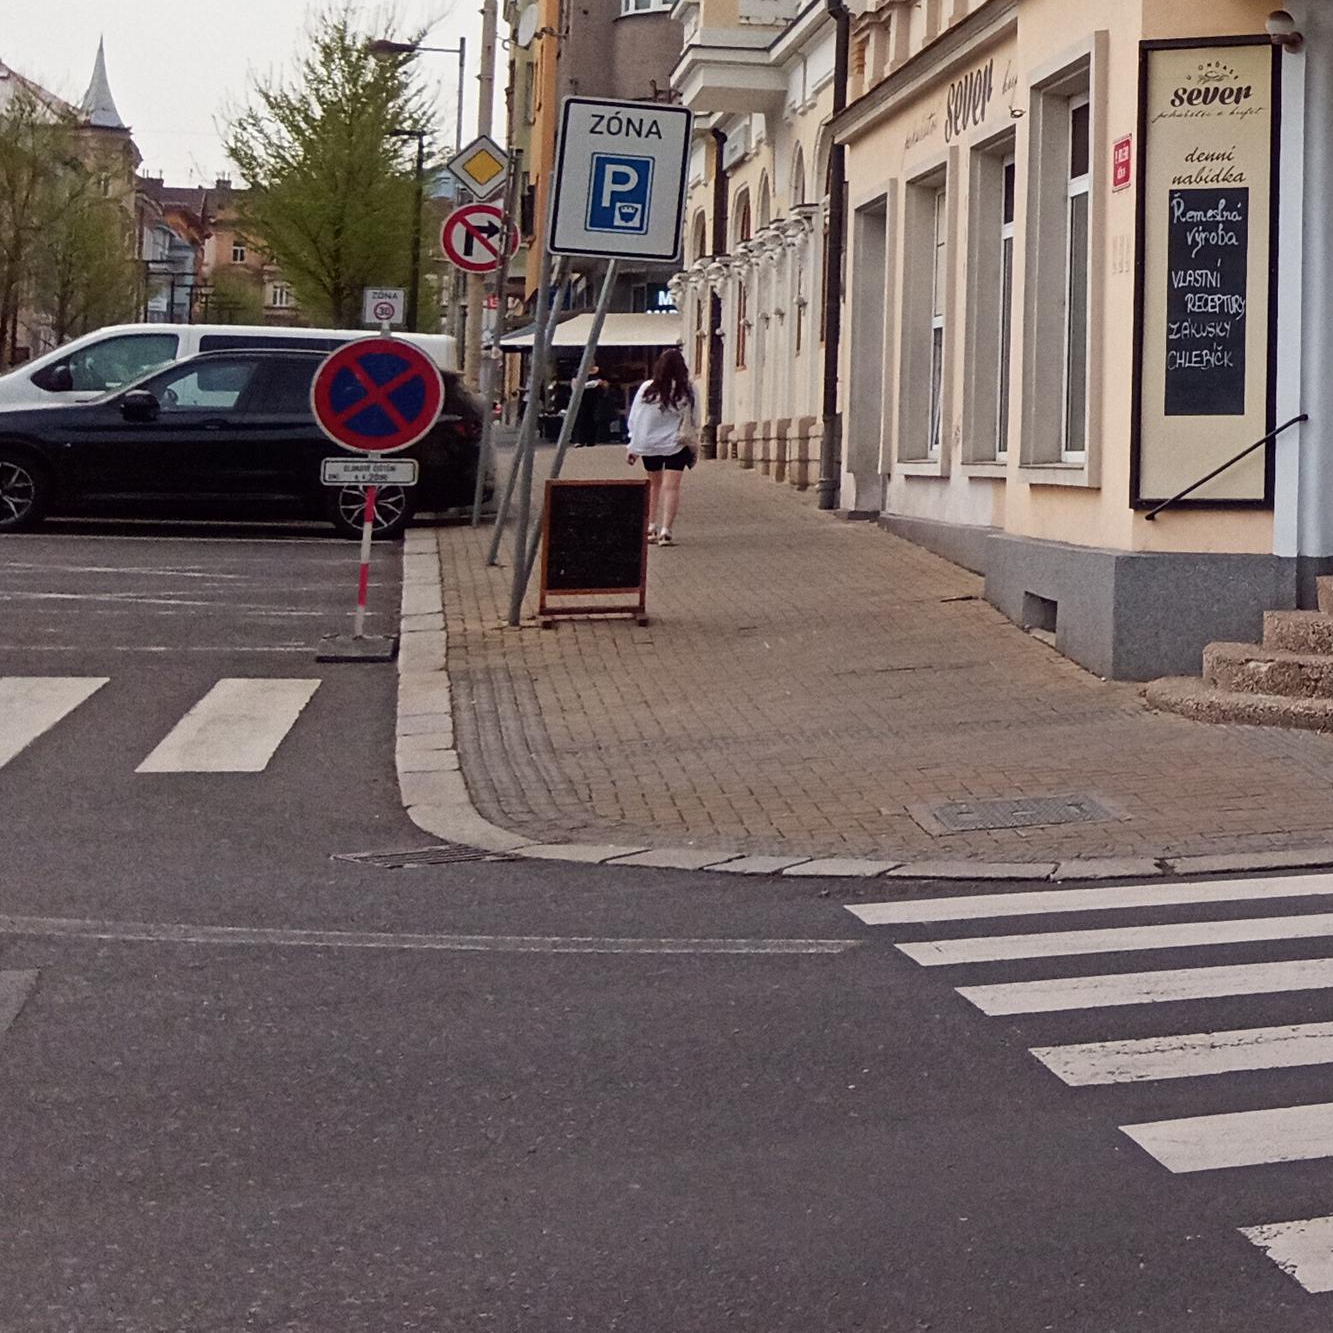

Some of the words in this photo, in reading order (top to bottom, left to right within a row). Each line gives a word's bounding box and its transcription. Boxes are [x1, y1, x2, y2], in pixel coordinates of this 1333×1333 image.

[945, 58, 994, 144] sever
[1170, 85, 1253, 107] sever
[589, 111, 663, 140] ZÓNA
[1185, 145, 1237, 164] denní
[601, 164, 639, 208] P
[1171, 166, 1247, 186] nabídka
[1171, 259, 1221, 289] VLASTNÍ
[1184, 293, 1246, 321] RECEPTURY
